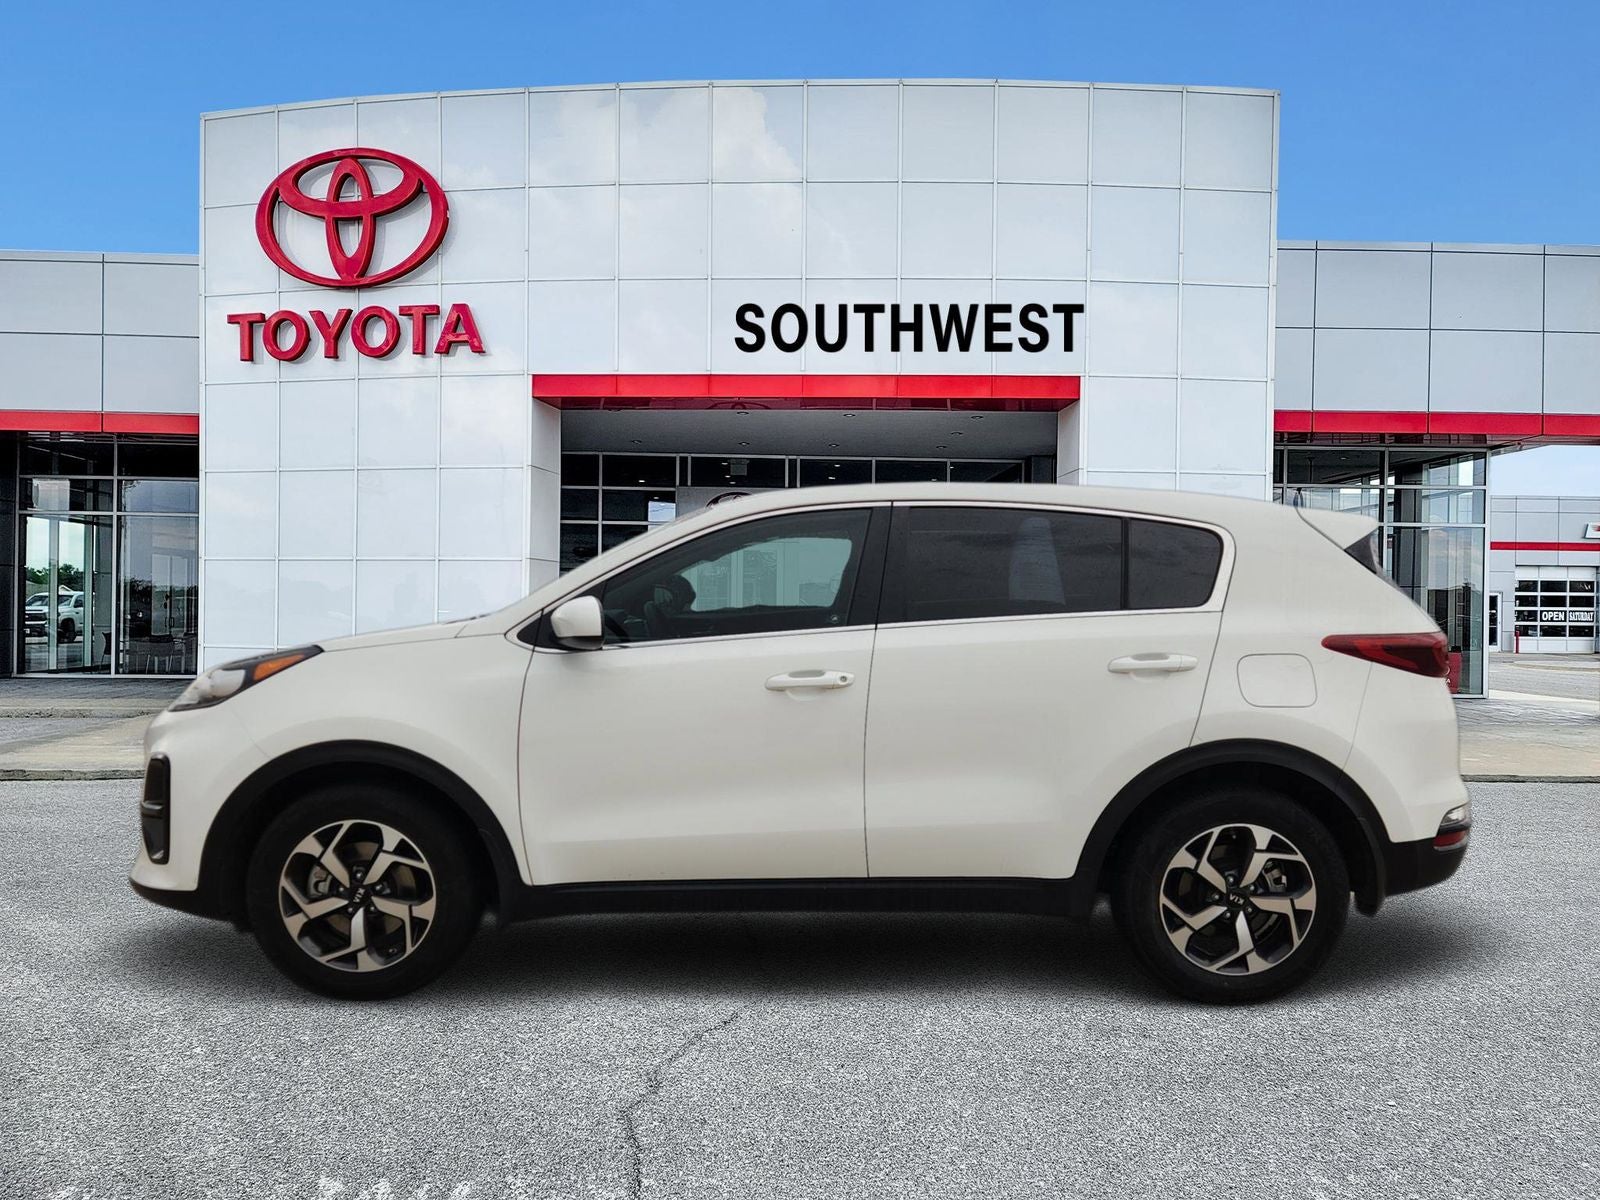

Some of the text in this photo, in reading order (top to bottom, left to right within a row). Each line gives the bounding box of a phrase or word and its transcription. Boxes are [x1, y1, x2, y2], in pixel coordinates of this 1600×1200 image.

[227, 304, 486, 361] TOYOTA
[734, 303, 1084, 352] SOUTHWEST
[1542, 611, 1594, 621] OPEN SATURDAY
